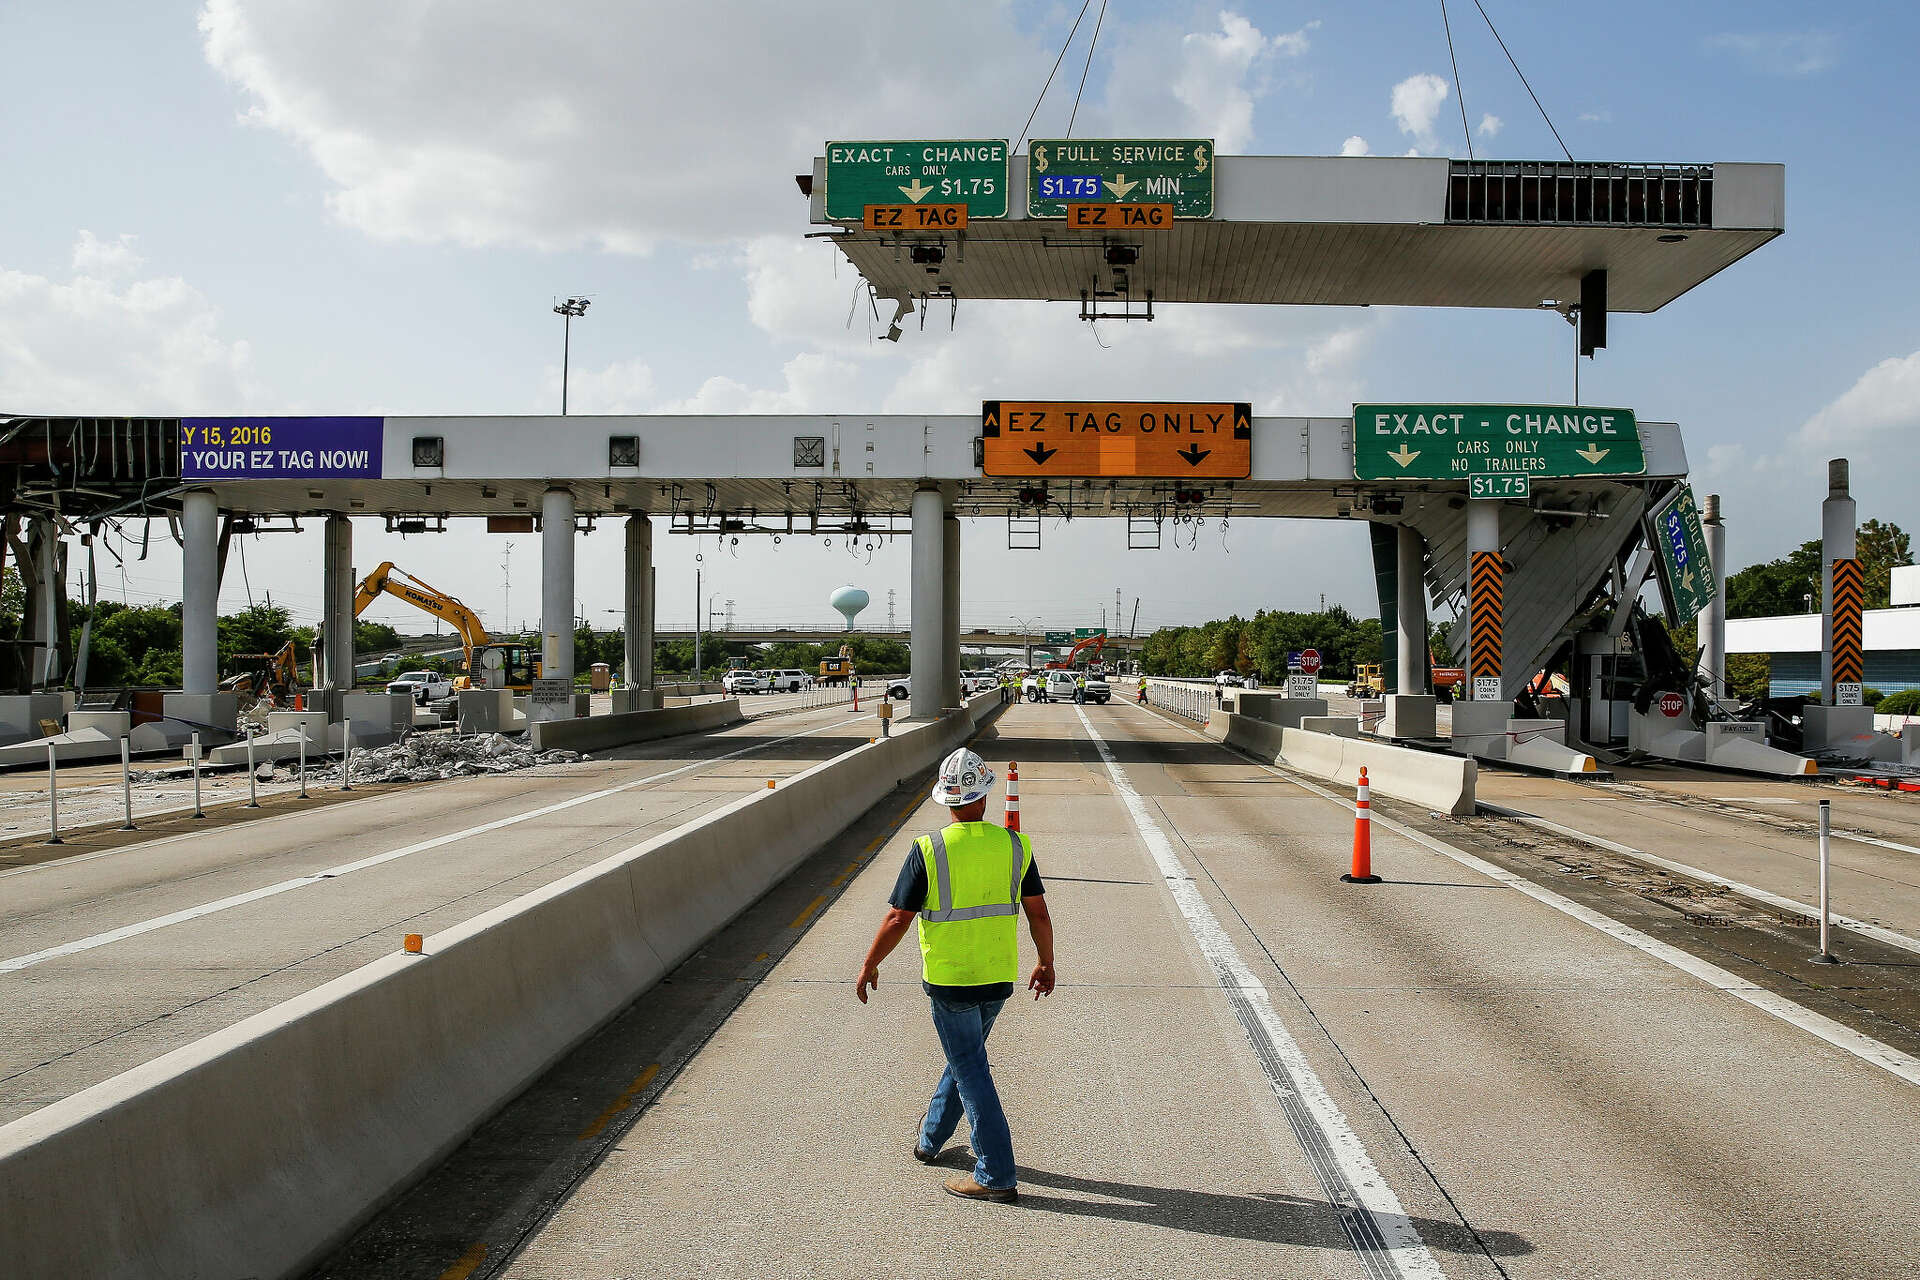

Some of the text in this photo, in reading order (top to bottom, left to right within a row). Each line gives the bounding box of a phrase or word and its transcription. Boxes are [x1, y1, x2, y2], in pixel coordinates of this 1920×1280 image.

[831, 148, 894, 163] EXACT
[923, 147, 1002, 162] CHANGE
[1034, 145, 1049, 173] $
[1057, 146, 1185, 161] FULL SERVICE
[1193, 145, 1208, 173] $
[885, 165, 948, 176] CARS ONLY
[941, 177, 995, 196] $1.75
[1042, 177, 1098, 196] $1.75
[1146, 177, 1185, 196] MIN.
[873, 208, 958, 226] EZ TAG
[1077, 207, 1163, 225] EZ TAG
[1008, 412, 1225, 434] EZ TAG ONLY
[1375, 414, 1464, 435] EXACT
[1506, 414, 1617, 435] CHANGE
[201, 427, 226, 448] 15,
[230, 426, 272, 445] 2016
[1457, 440, 1539, 453] CARS ONLY
[193, 451, 246, 469] YOUR
[250, 451, 274, 469] EZ
[278, 451, 315, 469] TAG
[319, 450, 369, 469] NOW!
[1451, 457, 1546, 471] NO TRAILERS
[1473, 477, 1526, 495] $1.75
[1669, 515, 1687, 563] $1.75
[1684, 511, 1702, 551] FULL
[405, 590, 444, 611] KOMATSU
[1301, 656, 1319, 667] STOP
[1661, 700, 1683, 711] STOP
